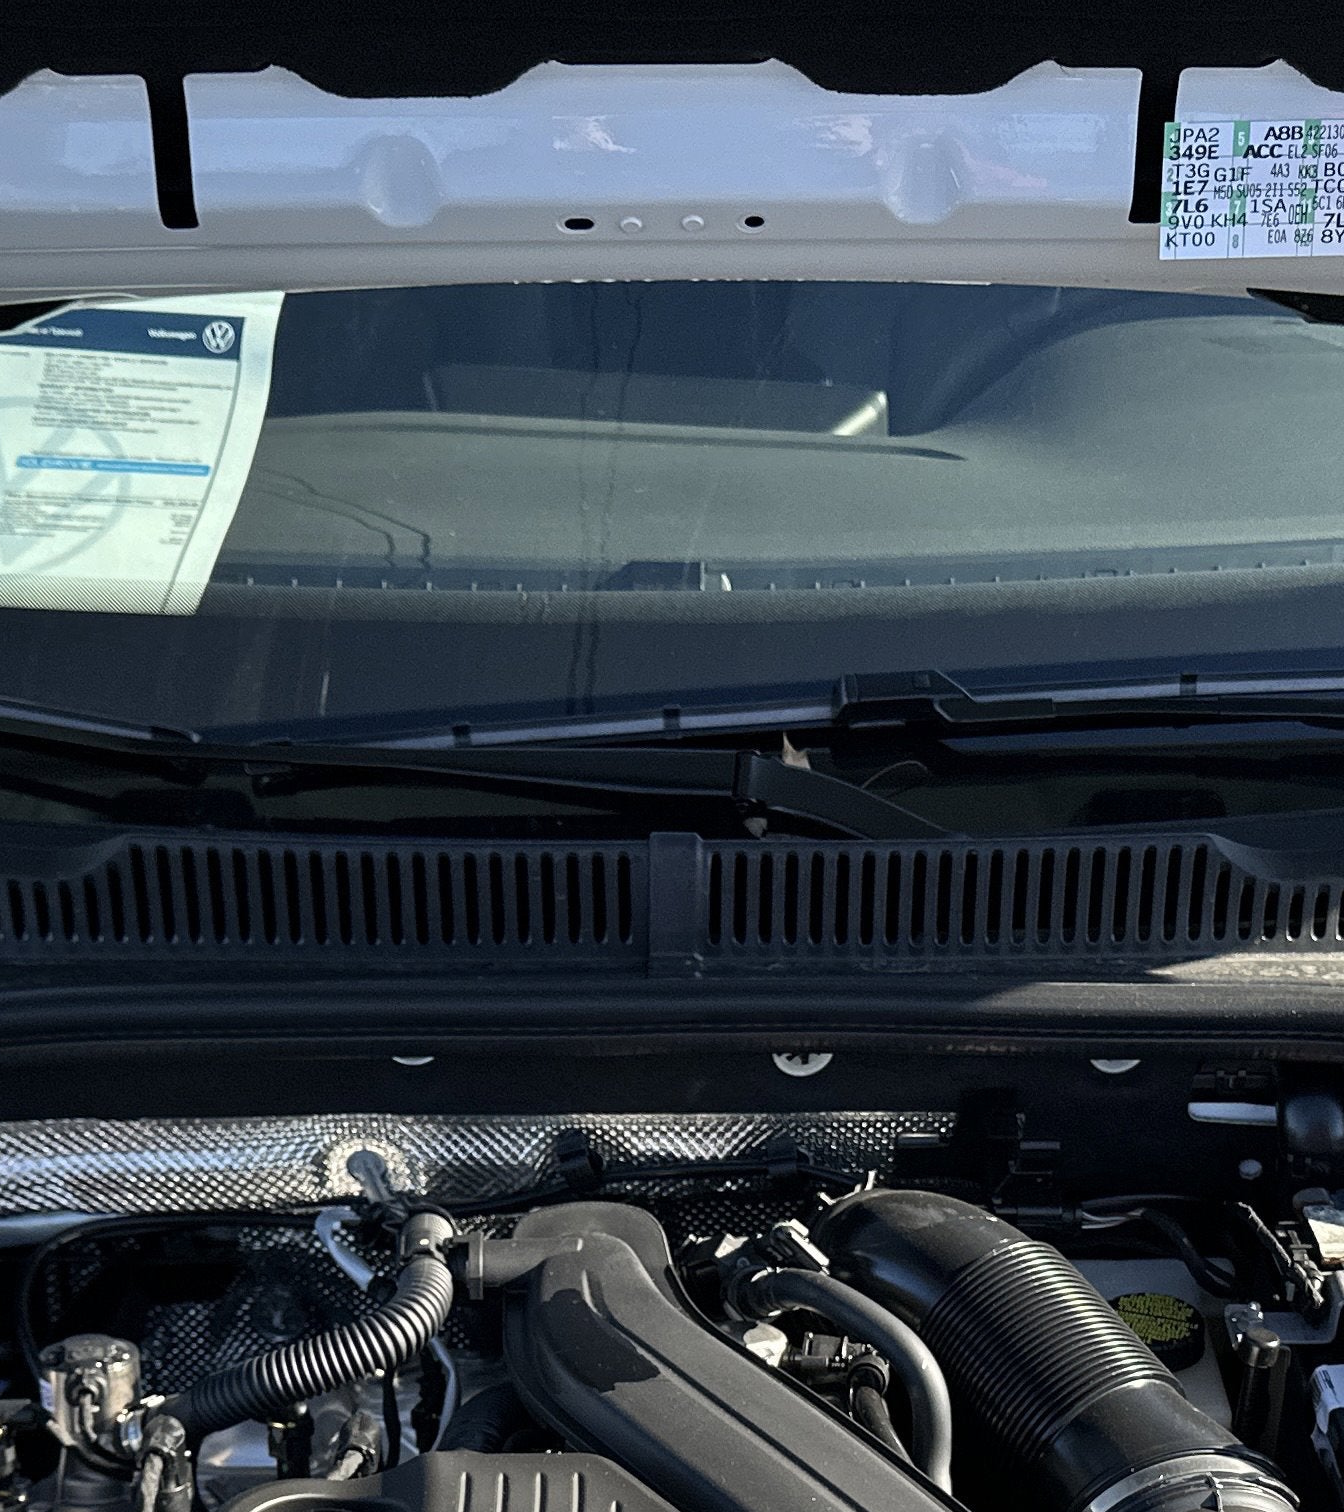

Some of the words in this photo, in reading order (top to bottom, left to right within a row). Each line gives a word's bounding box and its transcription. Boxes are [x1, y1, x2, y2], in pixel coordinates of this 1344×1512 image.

[1264, 126, 1303, 140] A8B
[1169, 145, 1219, 160] 349E
[1243, 145, 1282, 158] ACC
[1173, 164, 1209, 178] T3G
[1271, 164, 1290, 178] 4A3
[1173, 180, 1209, 196] 1E7
[1172, 199, 1208, 213] 7L6
[1251, 199, 1286, 214] 1SA
[1212, 214, 1248, 227] KH4
